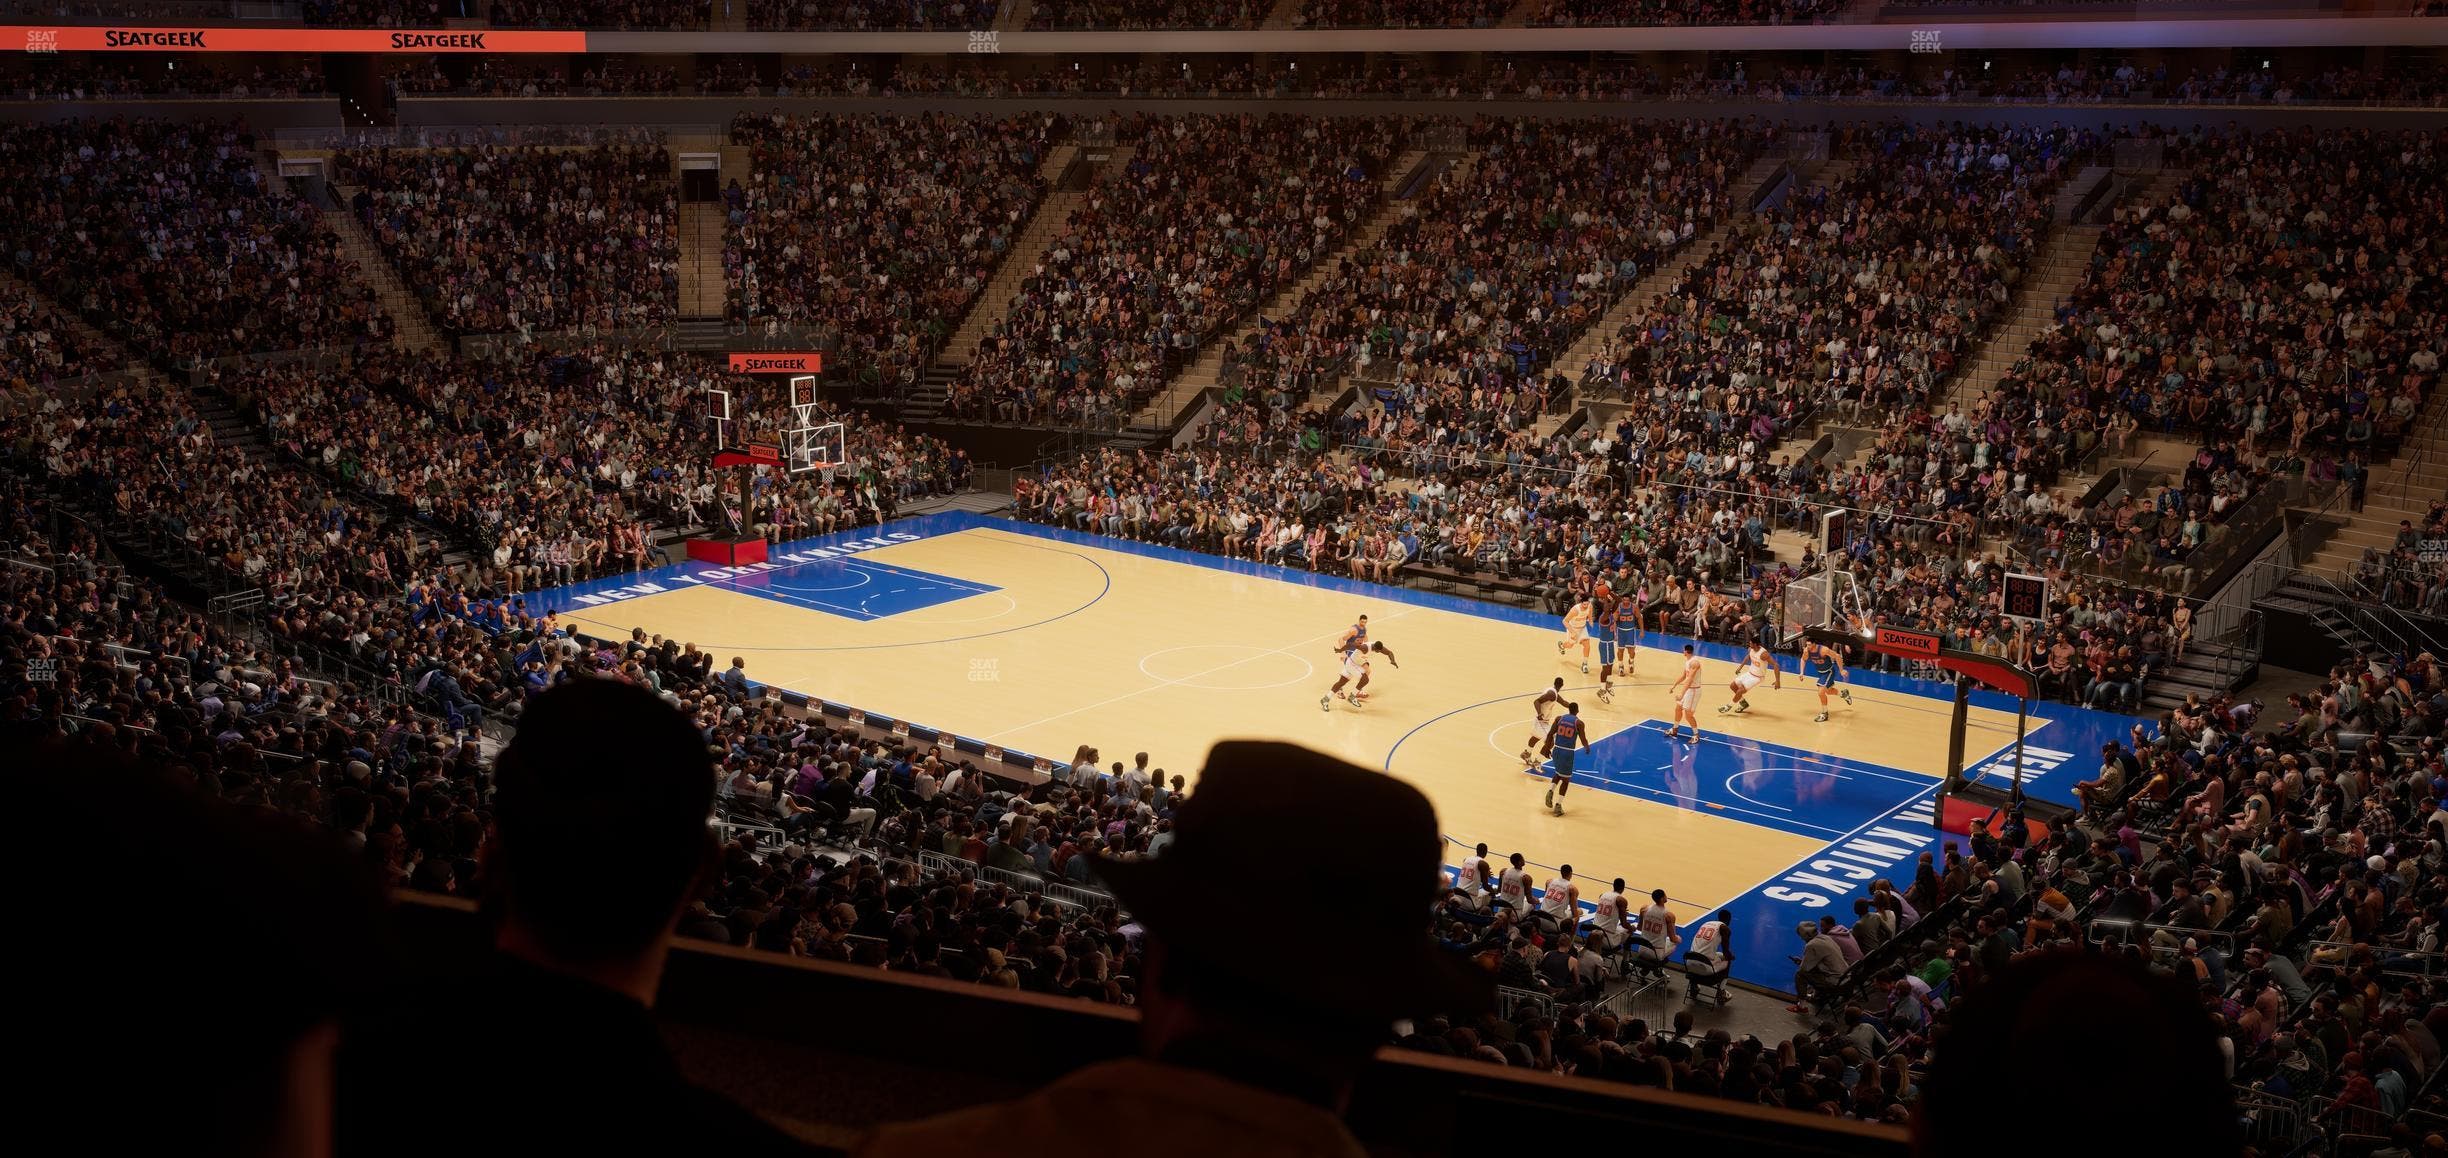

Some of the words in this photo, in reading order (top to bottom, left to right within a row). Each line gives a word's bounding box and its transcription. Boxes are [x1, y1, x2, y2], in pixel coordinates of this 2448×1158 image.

[105, 30, 207, 48] SEATGEEK
[391, 33, 486, 49] SEATGEEK
[745, 358, 807, 370] SEATGEEK
[751, 446, 776, 458] SEATGEEK
[572, 582, 668, 605] NEW
[668, 561, 783, 584] YORK
[778, 532, 921, 563] KNICKS
[1883, 632, 1932, 650] SEATGEEK
[1557, 725, 1574, 738] 00
[1977, 745, 2076, 784] NEW
[1762, 826, 1935, 908] KNICKS
